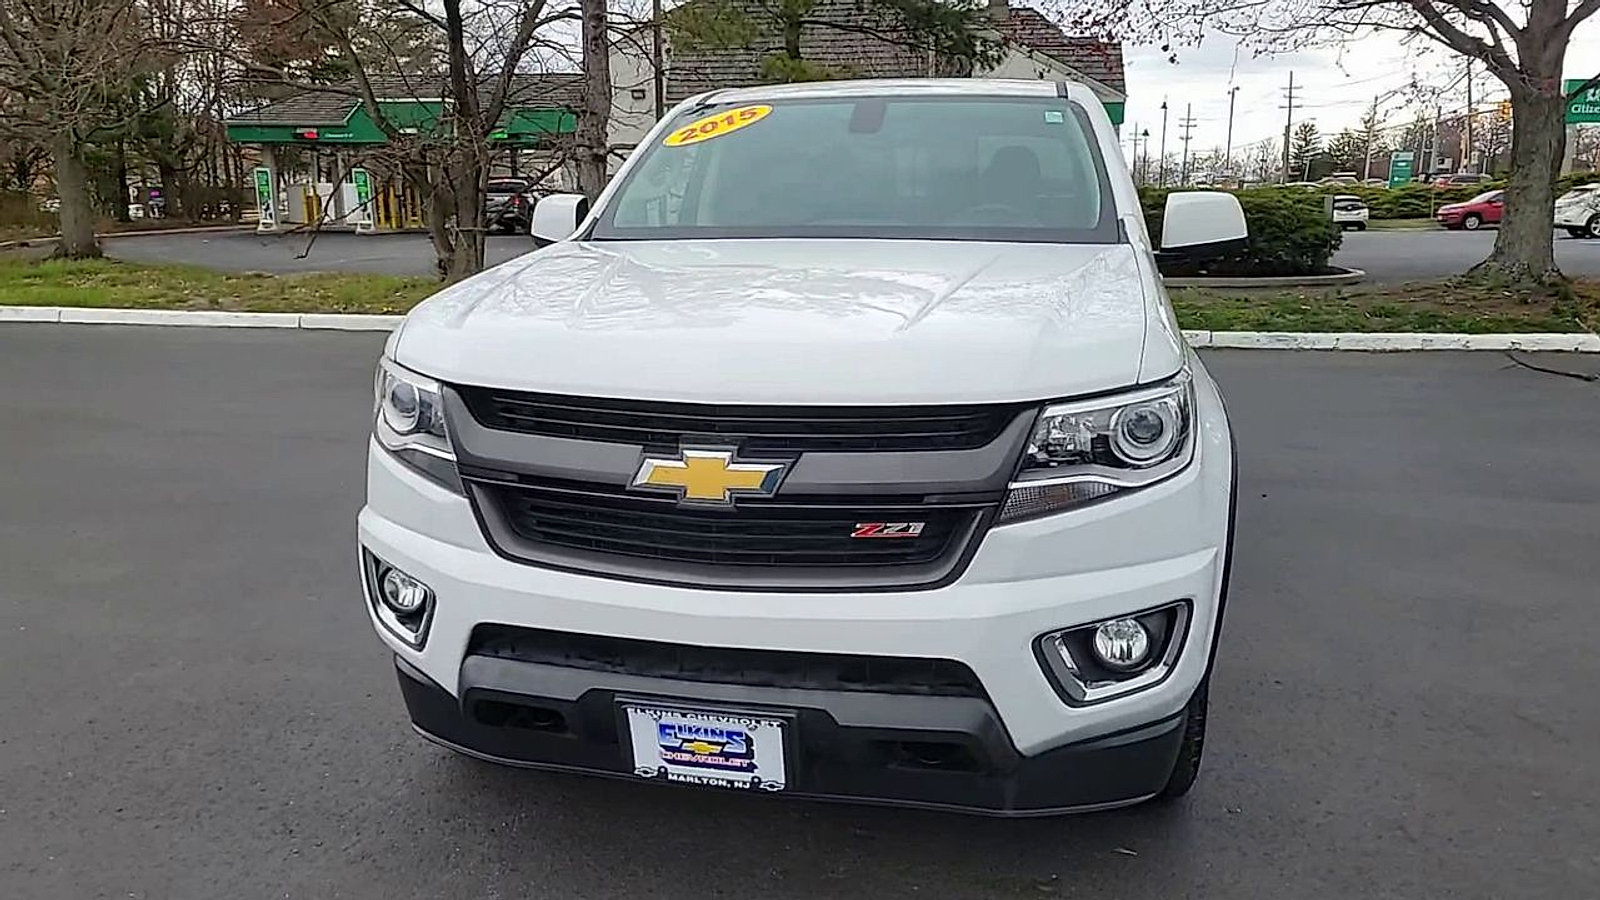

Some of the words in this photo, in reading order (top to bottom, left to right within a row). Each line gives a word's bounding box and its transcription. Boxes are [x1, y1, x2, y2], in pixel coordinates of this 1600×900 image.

[679, 109, 757, 142] 2015
[850, 522, 926, 538] Z71
[659, 723, 748, 753] ELKINS
[661, 751, 750, 767] CHEVROLET
[733, 780, 751, 789] NJ
